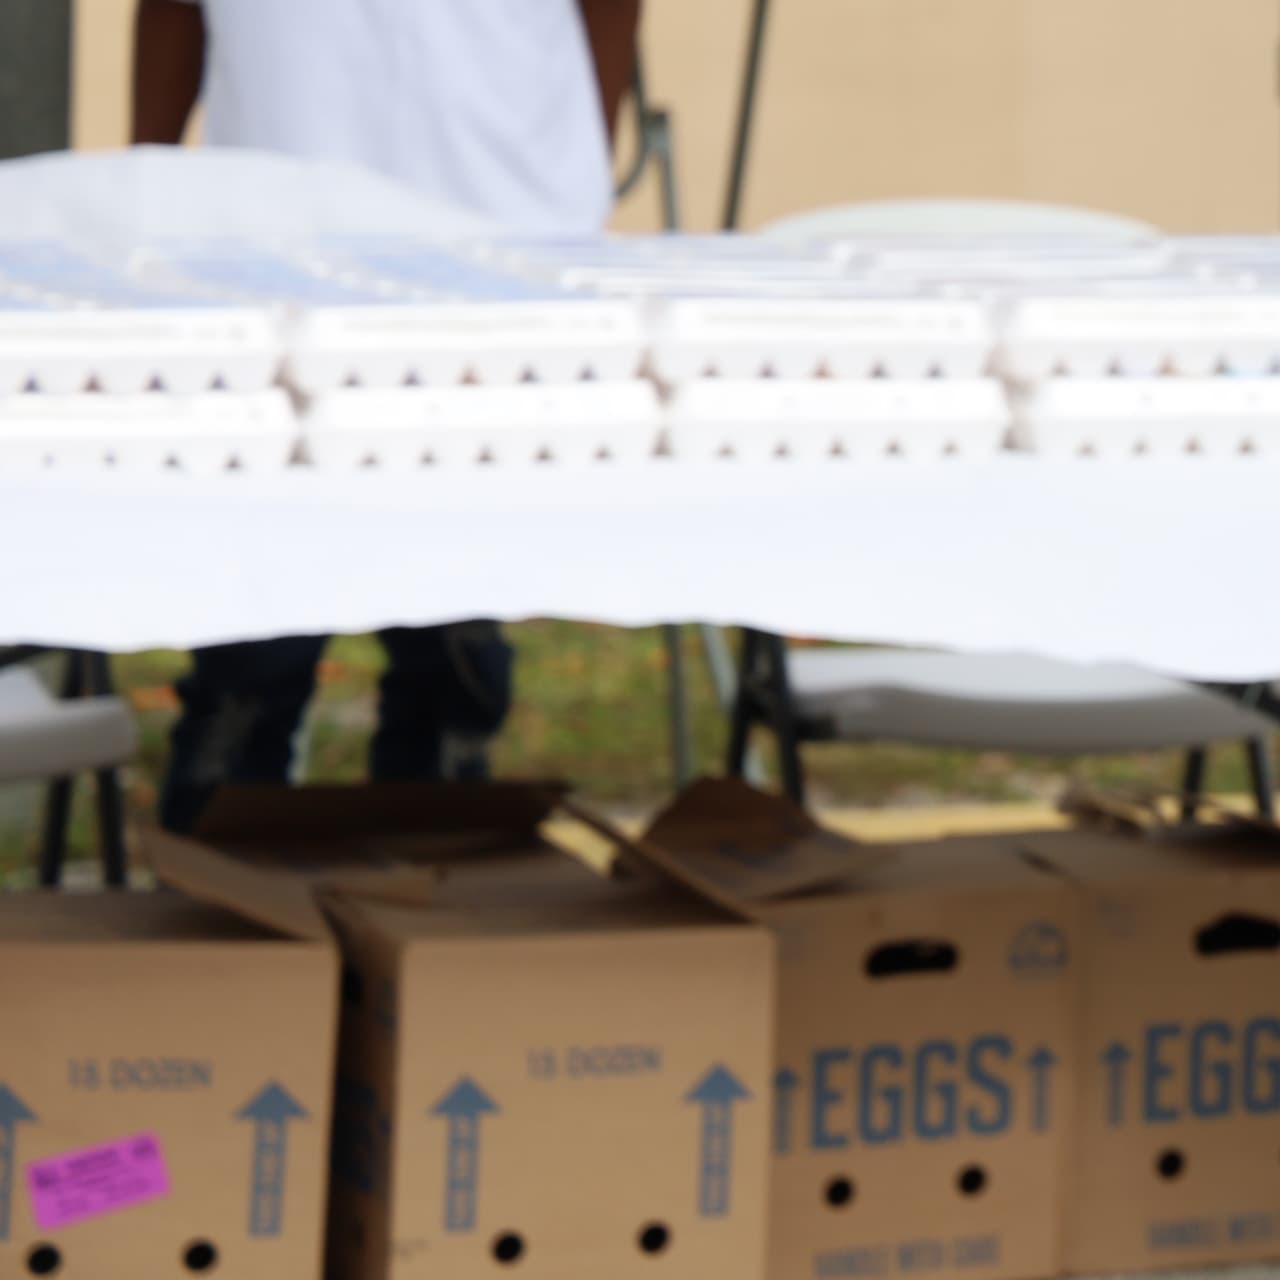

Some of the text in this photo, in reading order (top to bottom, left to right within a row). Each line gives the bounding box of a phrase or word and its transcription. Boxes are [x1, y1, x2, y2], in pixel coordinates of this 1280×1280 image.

[110, 1058, 213, 1091] DOZEN
[567, 1045, 662, 1077] DOZEN
[811, 1034, 1014, 1151] EGGS
